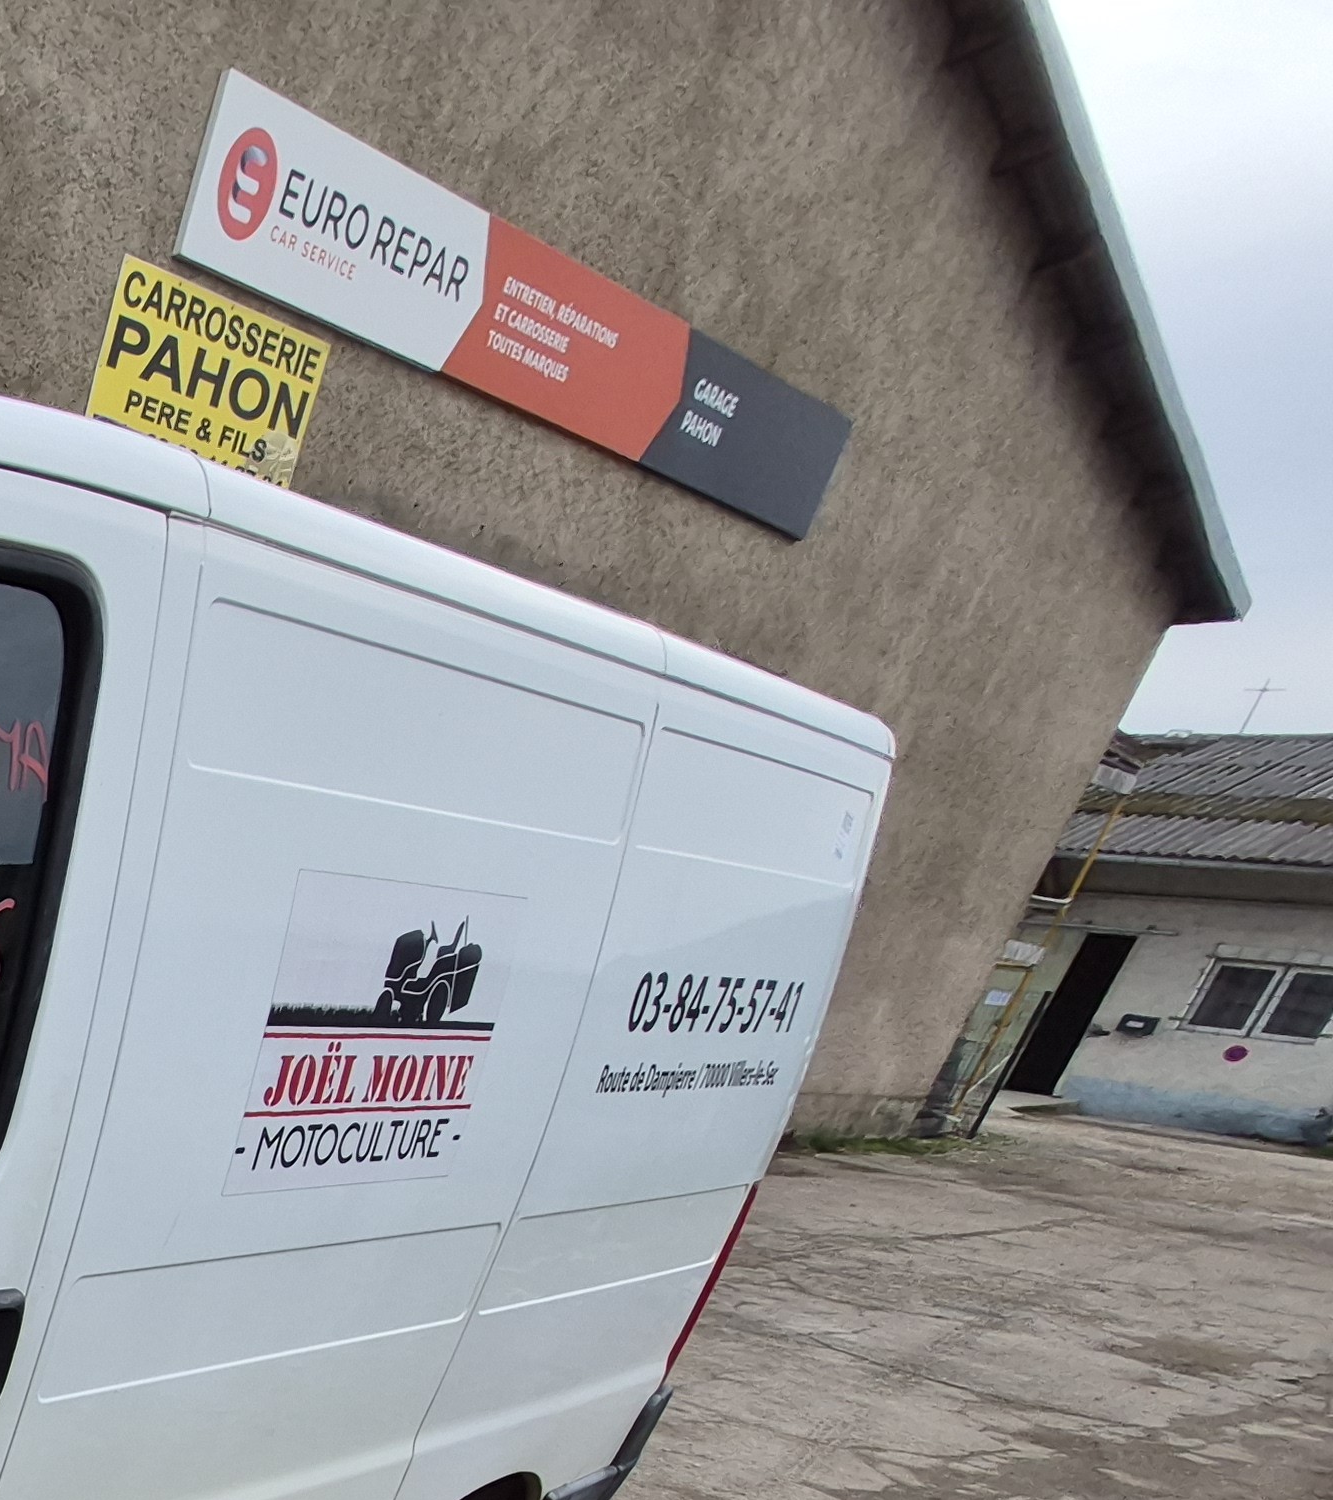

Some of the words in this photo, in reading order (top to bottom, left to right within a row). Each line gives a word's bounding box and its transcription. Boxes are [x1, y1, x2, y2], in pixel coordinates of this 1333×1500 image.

[269, 225, 298, 251] CAR
[301, 240, 357, 281] SERVICE
[278, 168, 370, 250] EURO
[369, 215, 469, 302] REPAR
[123, 270, 322, 384] CARROSSERIE
[494, 303, 510, 322] ET
[508, 310, 570, 353] CARROSSERIE
[503, 276, 557, 320] ENTRETIEN,
[556, 302, 619, 349] RÉPARATIONS
[106, 314, 310, 440] PAHON
[486, 330, 524, 361] TOUTES
[521, 348, 569, 383] MARQUES
[123, 389, 193, 435] PERE
[195, 417, 211, 443] &
[217, 425, 268, 463] FILS
[693, 378, 739, 418] GARAGE
[680, 410, 723, 447] PAHON
[627, 971, 805, 1034] 03-84-75-57-41
[263, 1041, 357, 1107] JOËL
[361, 1054, 474, 1103] MOINE
[595, 1064, 629, 1094] Route
[628, 1062, 645, 1092] de
[643, 1062, 697, 1098] Dampierre
[251, 1118, 450, 1171] MOTOCULTURE
